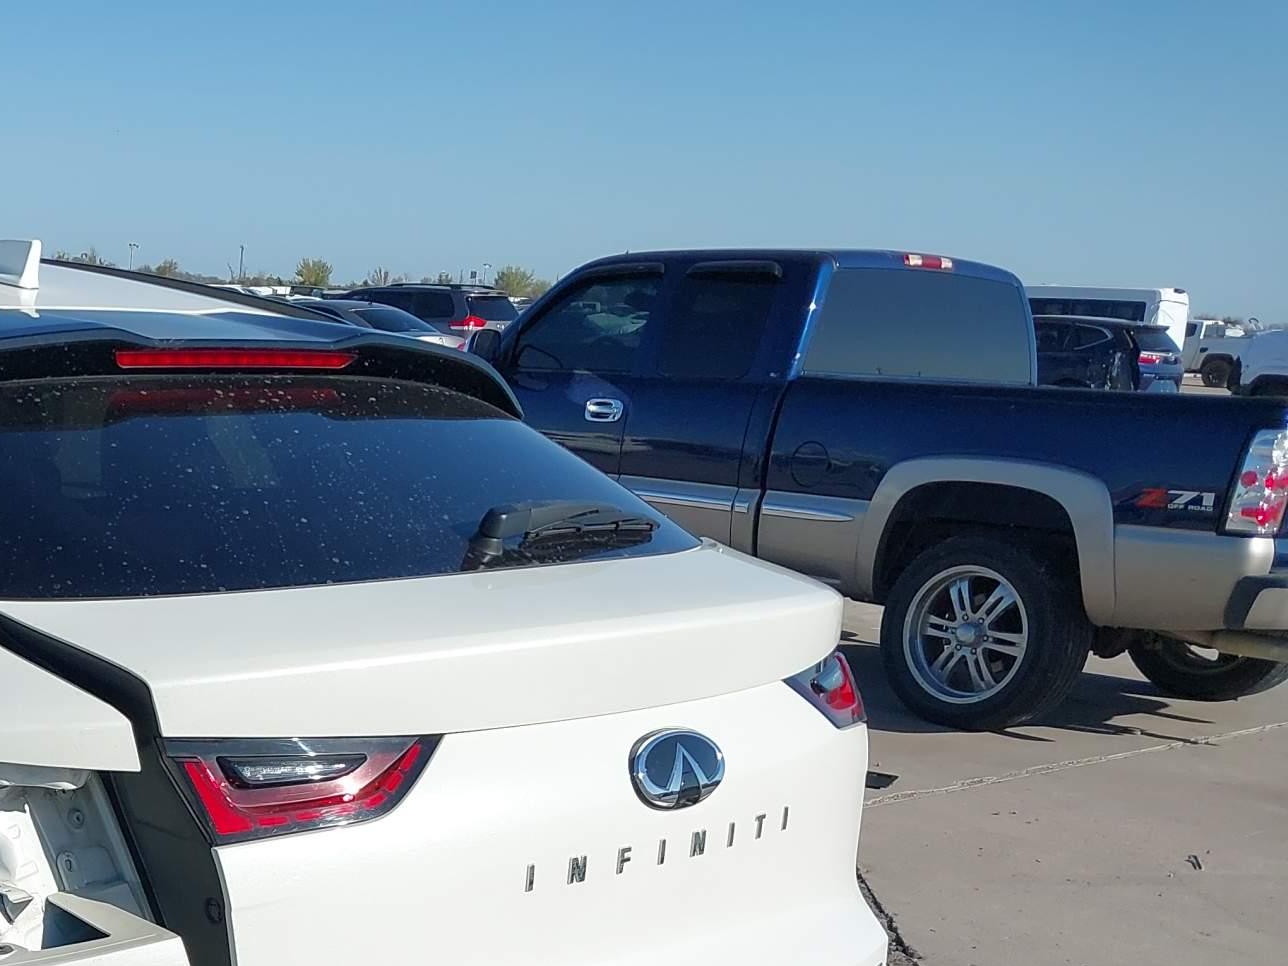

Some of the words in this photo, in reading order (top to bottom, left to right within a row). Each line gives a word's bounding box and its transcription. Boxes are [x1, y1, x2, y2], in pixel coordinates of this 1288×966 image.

[1136, 488, 1215, 507] Z71
[1168, 503, 1185, 511] OFF
[1188, 504, 1214, 512] ROAD
[524, 806, 789, 892] INFINITI
